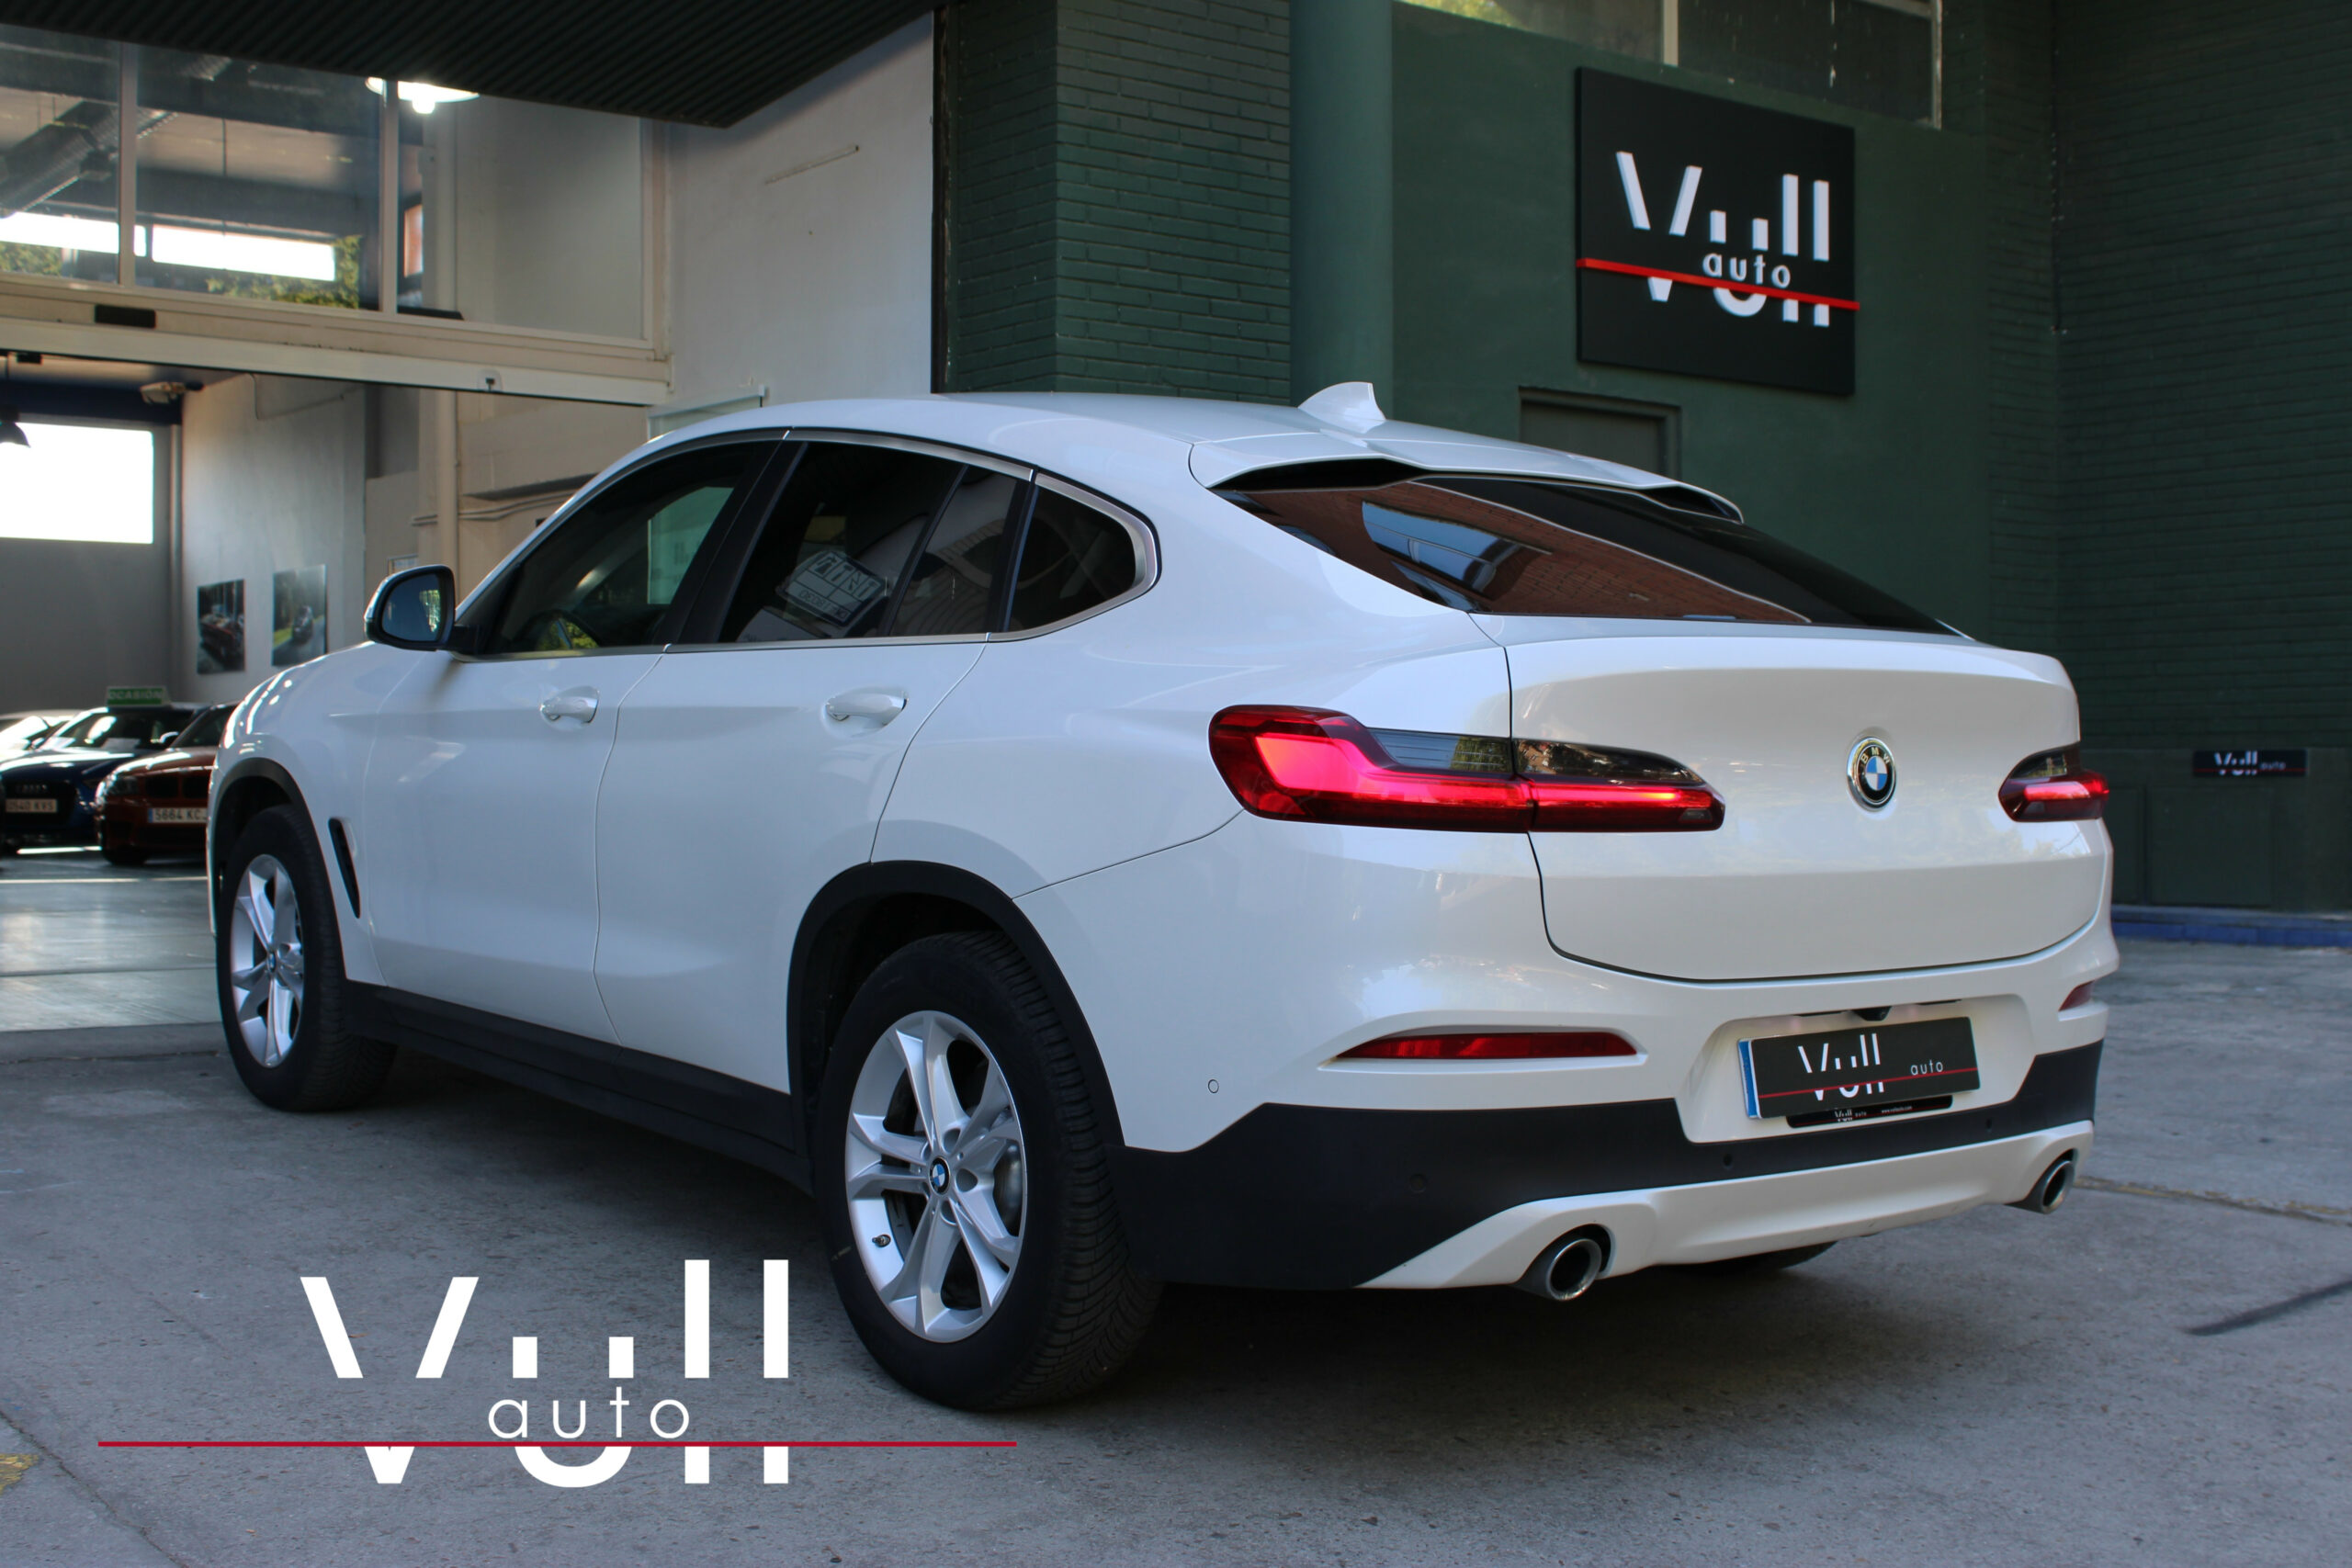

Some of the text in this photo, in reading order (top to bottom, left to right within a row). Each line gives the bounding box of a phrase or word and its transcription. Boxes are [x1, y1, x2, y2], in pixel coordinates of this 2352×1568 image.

[1615, 150, 1830, 327] Vull
[1702, 252, 1792, 289] auto
[1860, 746, 1892, 765] BMW
[2260, 761, 2287, 772] auto
[1910, 1058, 1944, 1077] auto
